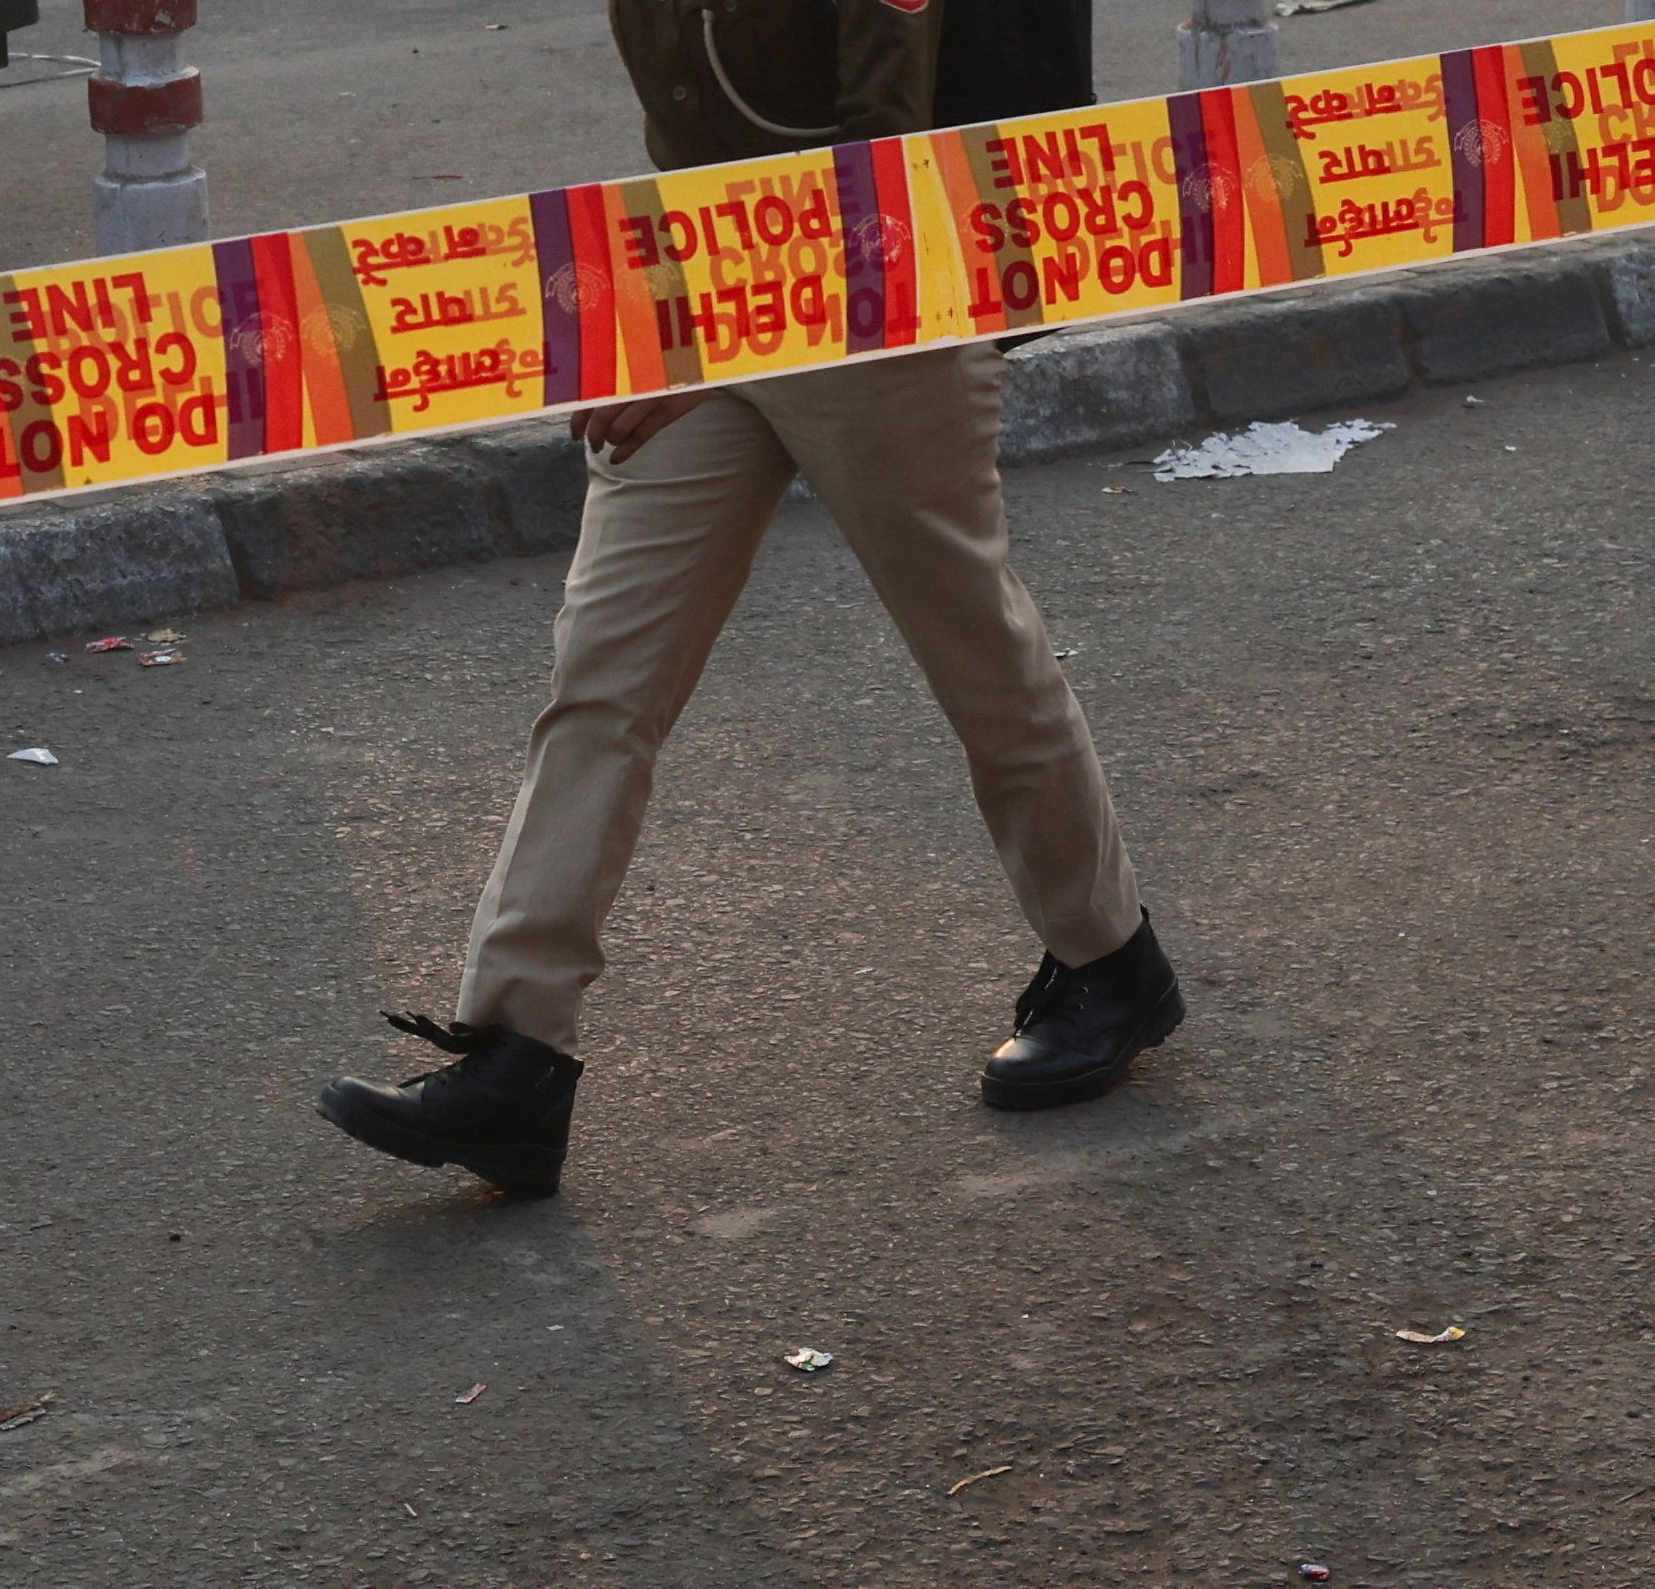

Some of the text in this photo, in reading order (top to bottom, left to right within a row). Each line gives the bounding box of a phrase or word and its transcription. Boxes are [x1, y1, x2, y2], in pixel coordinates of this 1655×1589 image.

[1284, 83, 1402, 140] न करें
[985, 123, 1115, 190] LINE
[1318, 144, 1391, 184] पार
[618, 189, 833, 270] POLICE
[970, 180, 1154, 253] CROSS
[1304, 198, 1419, 258] लाईन
[351, 225, 487, 287] न करें
[968, 237, 1173, 319] DO NOT
[2, 272, 153, 344] LINE
[390, 291, 474, 334] पार
[655, 275, 827, 351] DELHI
[373, 349, 506, 413] लाईन
[132, 394, 219, 455] DO
